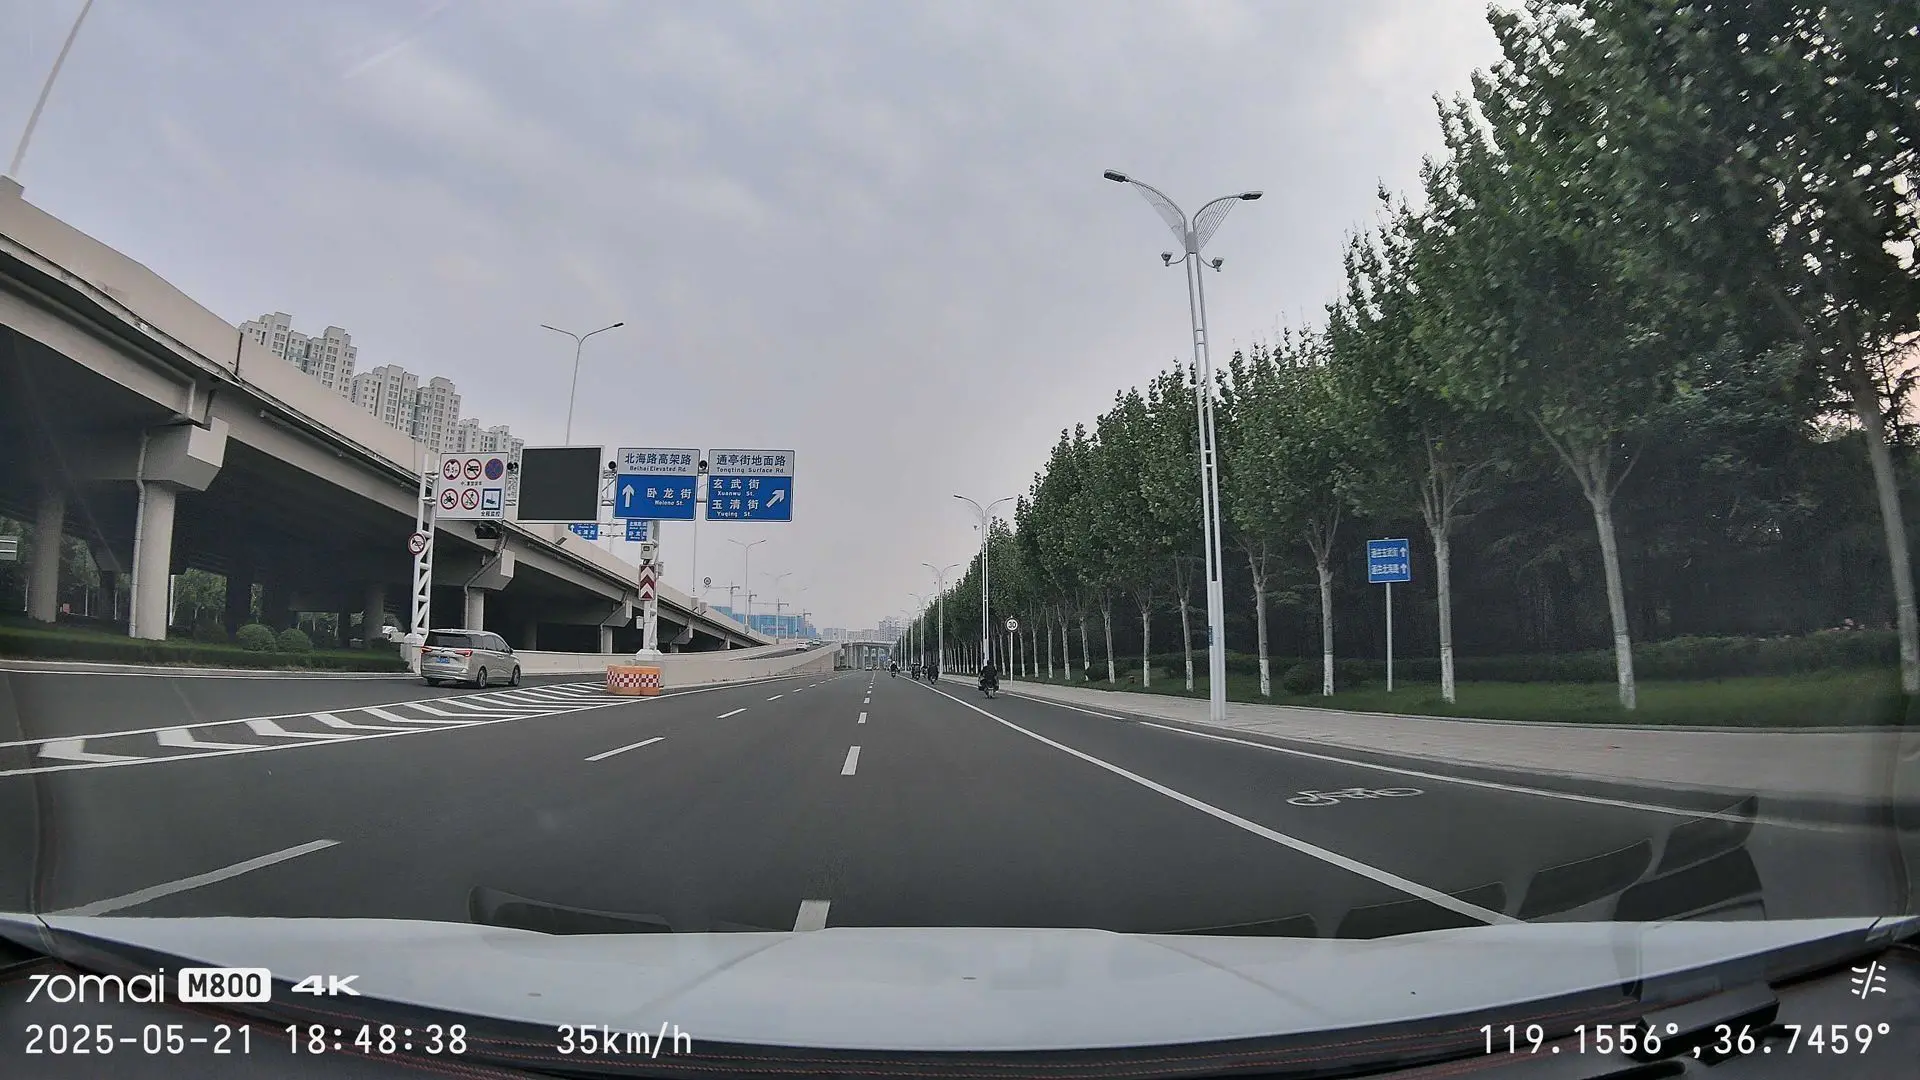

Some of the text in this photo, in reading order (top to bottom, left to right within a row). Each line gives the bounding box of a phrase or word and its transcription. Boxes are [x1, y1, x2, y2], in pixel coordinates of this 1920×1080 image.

[625, 453, 692, 465] 北海路高架路
[717, 454, 786, 466] 通亭街地面路
[713, 479, 760, 490] 玄武街
[647, 488, 692, 499] 卧龙街
[712, 499, 759, 510] 玉清街
